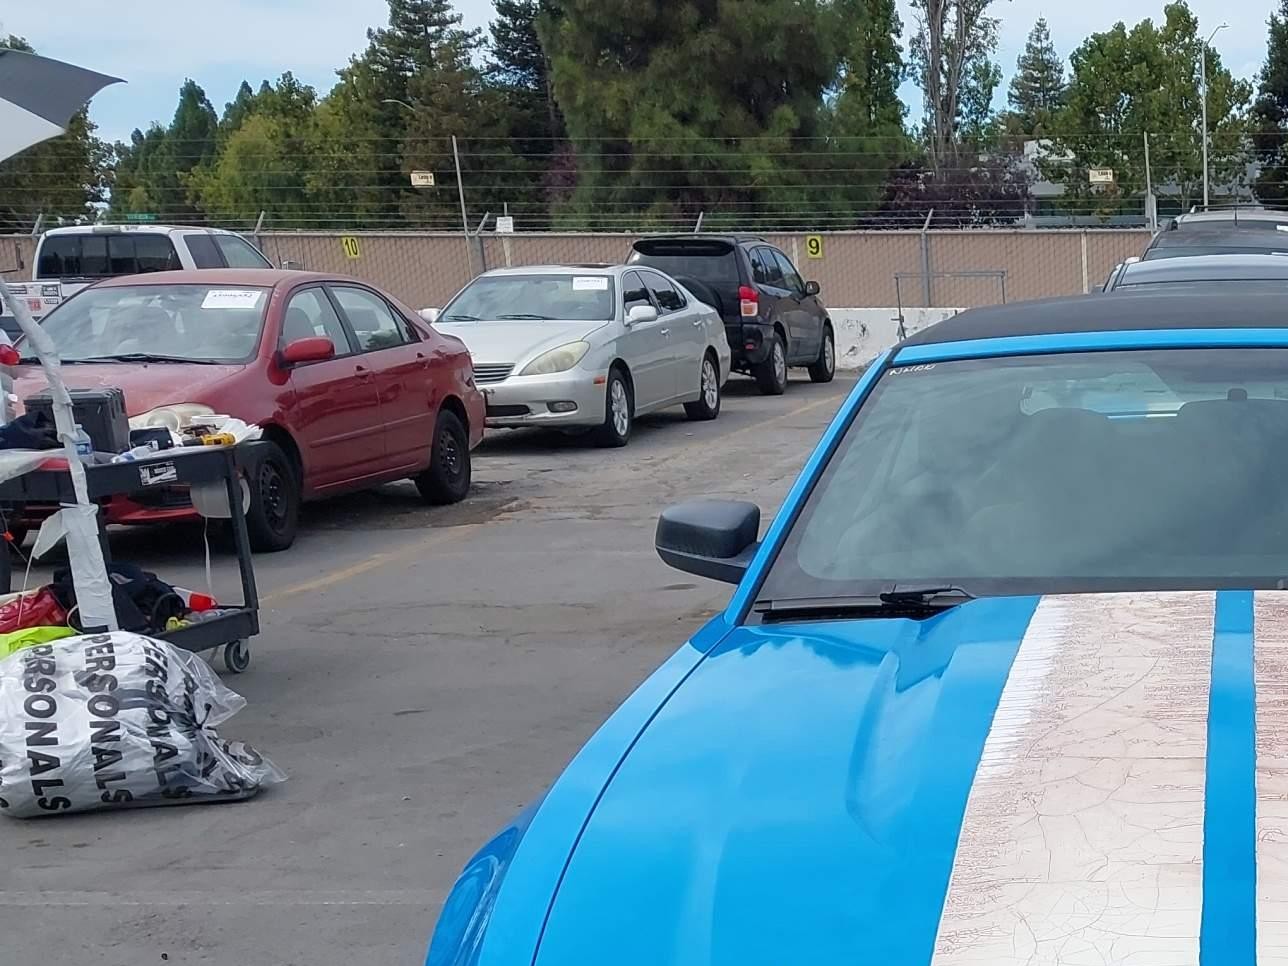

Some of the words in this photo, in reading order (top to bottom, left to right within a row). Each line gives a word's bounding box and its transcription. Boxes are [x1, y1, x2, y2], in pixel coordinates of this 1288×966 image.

[344, 238, 358, 257] 10
[808, 238, 820, 255] 9
[82, 635, 133, 803] PERSONALS
